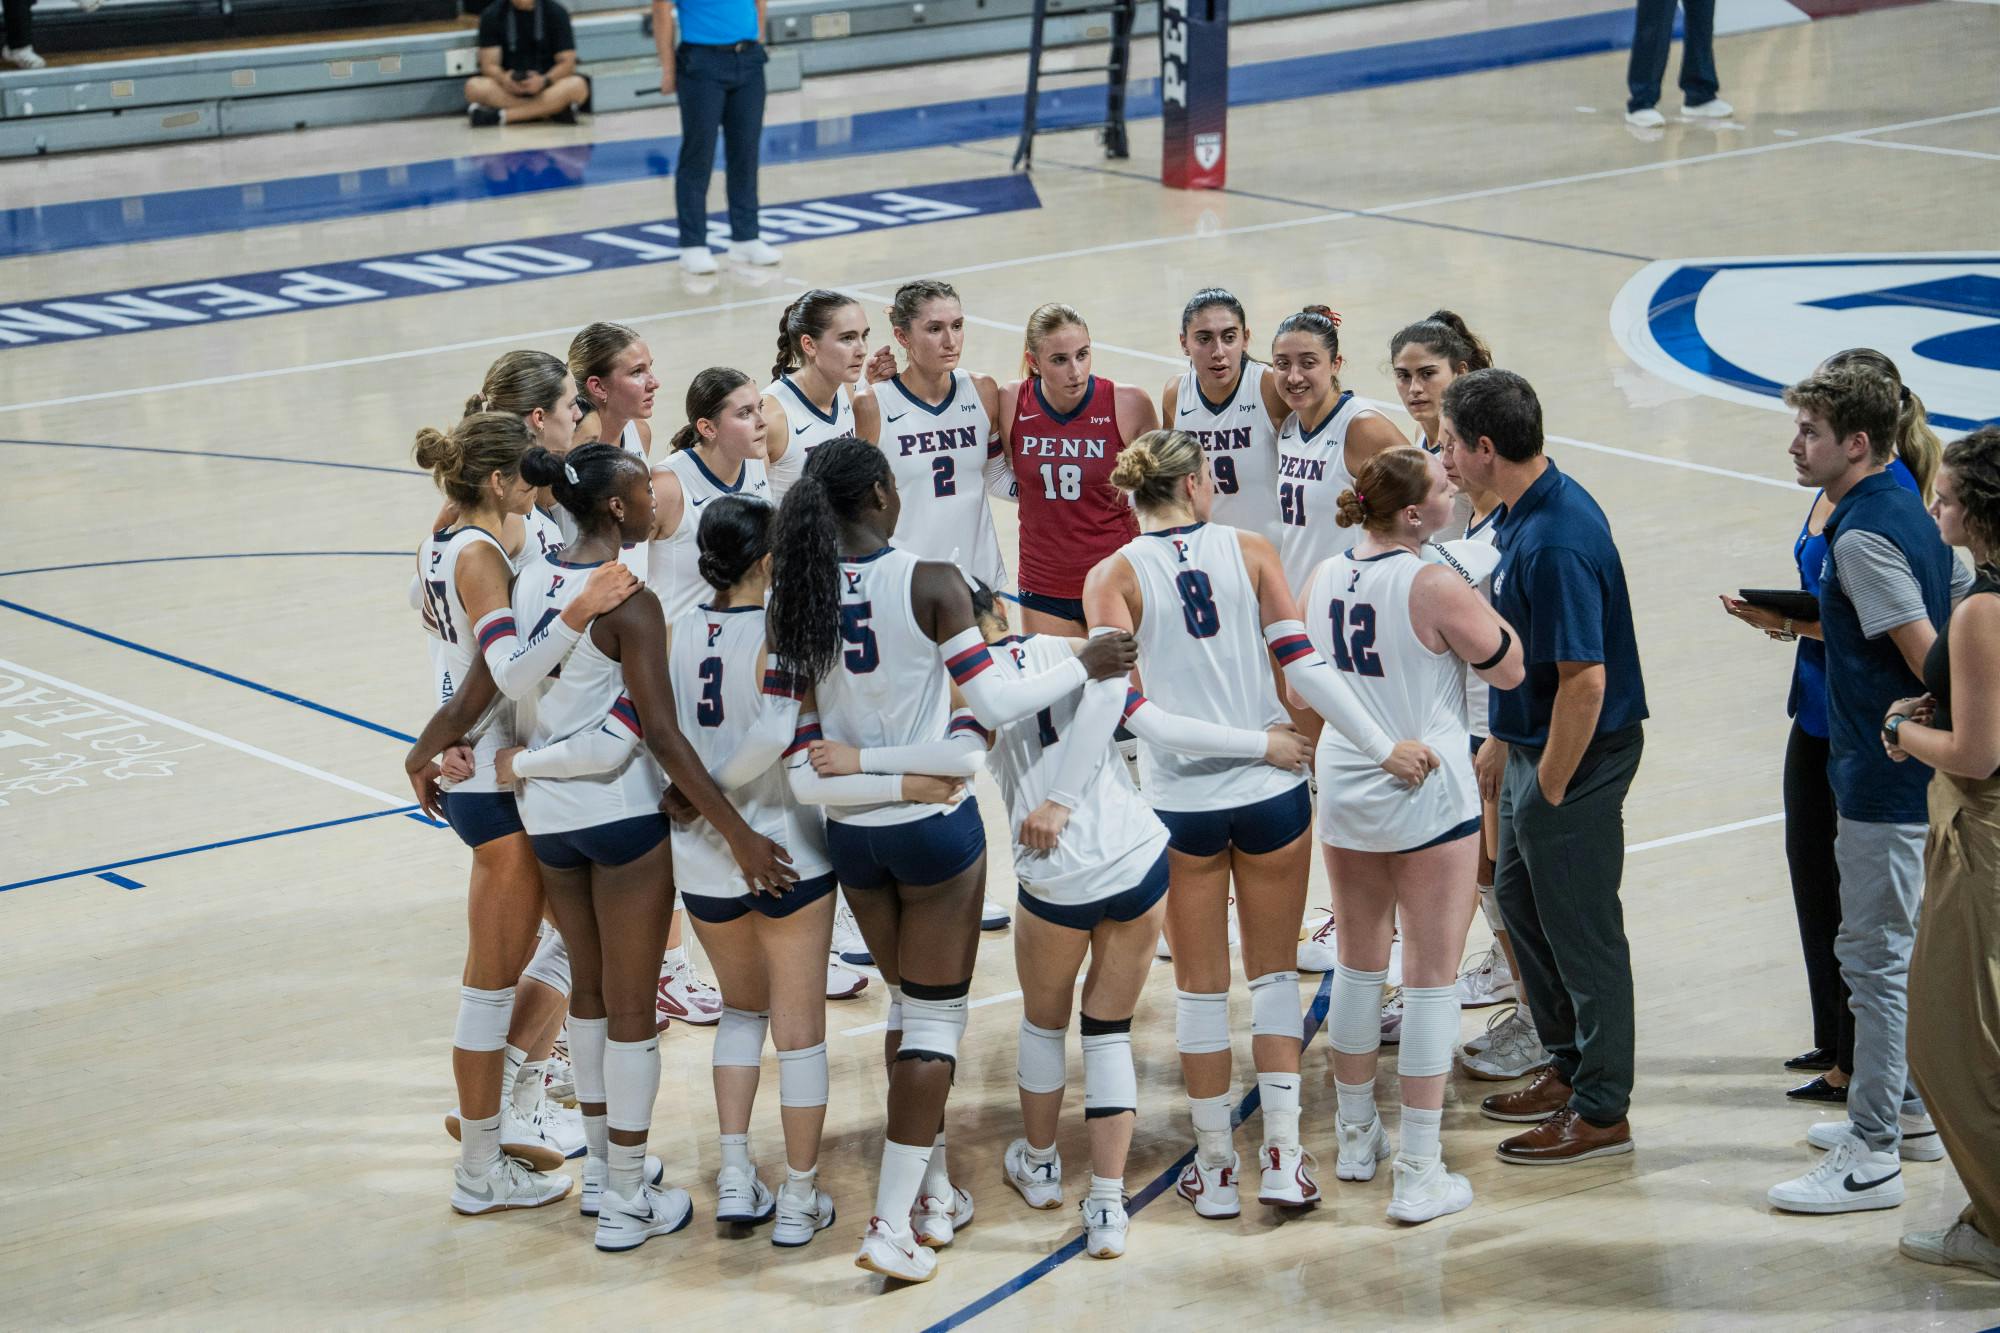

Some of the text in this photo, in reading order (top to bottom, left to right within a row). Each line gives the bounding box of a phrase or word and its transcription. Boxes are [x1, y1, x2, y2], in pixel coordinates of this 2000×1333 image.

[359, 245, 593, 289] ON
[1090, 416, 1104, 425] Ivy
[897, 425, 978, 457] PENN
[1020, 435, 1107, 459] PENN
[931, 455, 956, 498] 2
[1039, 463, 1083, 501] 18
[1278, 454, 1327, 481] PENN
[1279, 482, 1306, 527] 21
[430, 551, 442, 574] P
[1172, 540, 1189, 563] P
[1429, 542, 1475, 585] POWERAD
[545, 575, 565, 598] P
[844, 572, 862, 594] P
[1347, 569, 1361, 593] P
[1175, 569, 1221, 639] 8
[707, 623, 723, 648] P
[840, 600, 880, 675] 5
[1328, 598, 1385, 678] 12
[696, 656, 725, 728] 3
